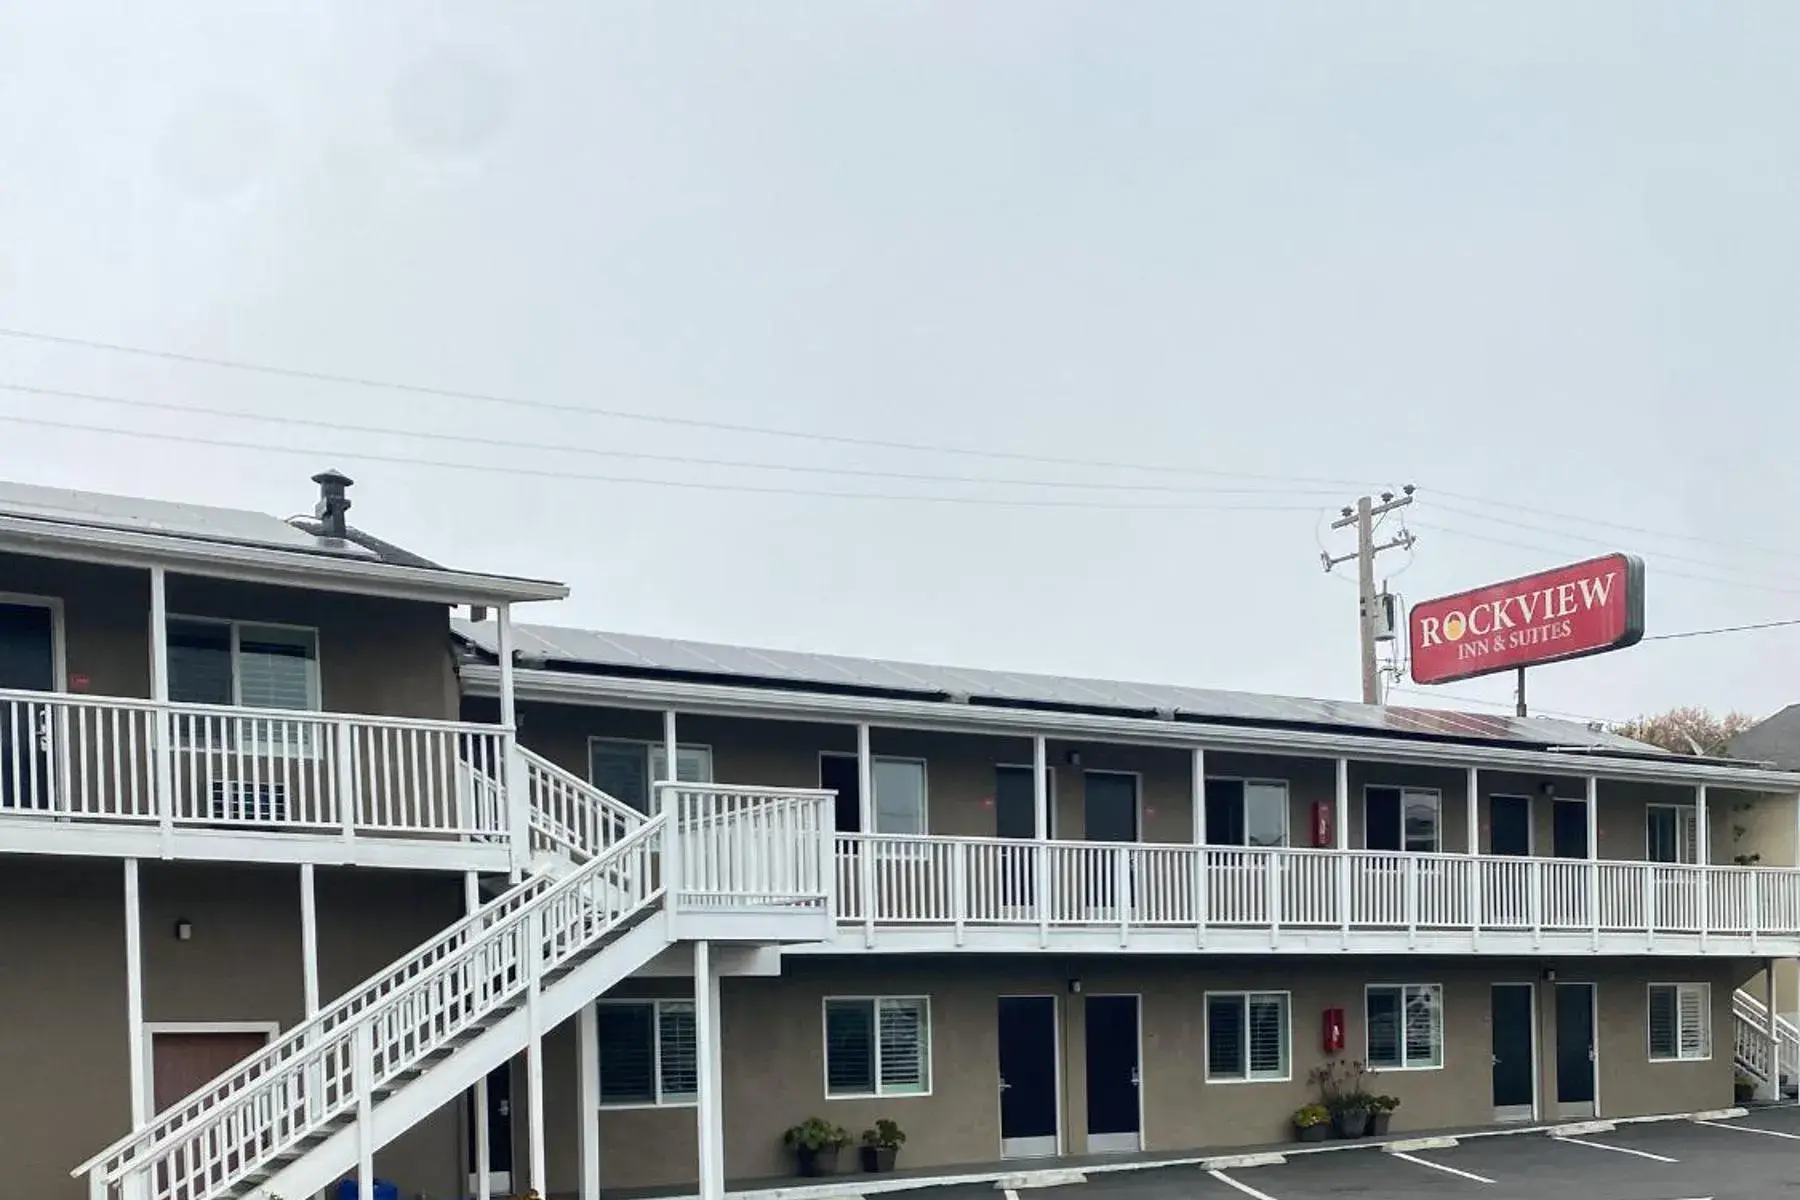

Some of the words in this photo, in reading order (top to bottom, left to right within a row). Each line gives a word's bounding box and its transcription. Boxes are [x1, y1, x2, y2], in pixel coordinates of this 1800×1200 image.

[1420, 572, 1616, 648] ROCKVIEW
[1457, 640, 1489, 659] INN
[1493, 633, 1504, 651] &
[1510, 620, 1572, 648] SUITES
